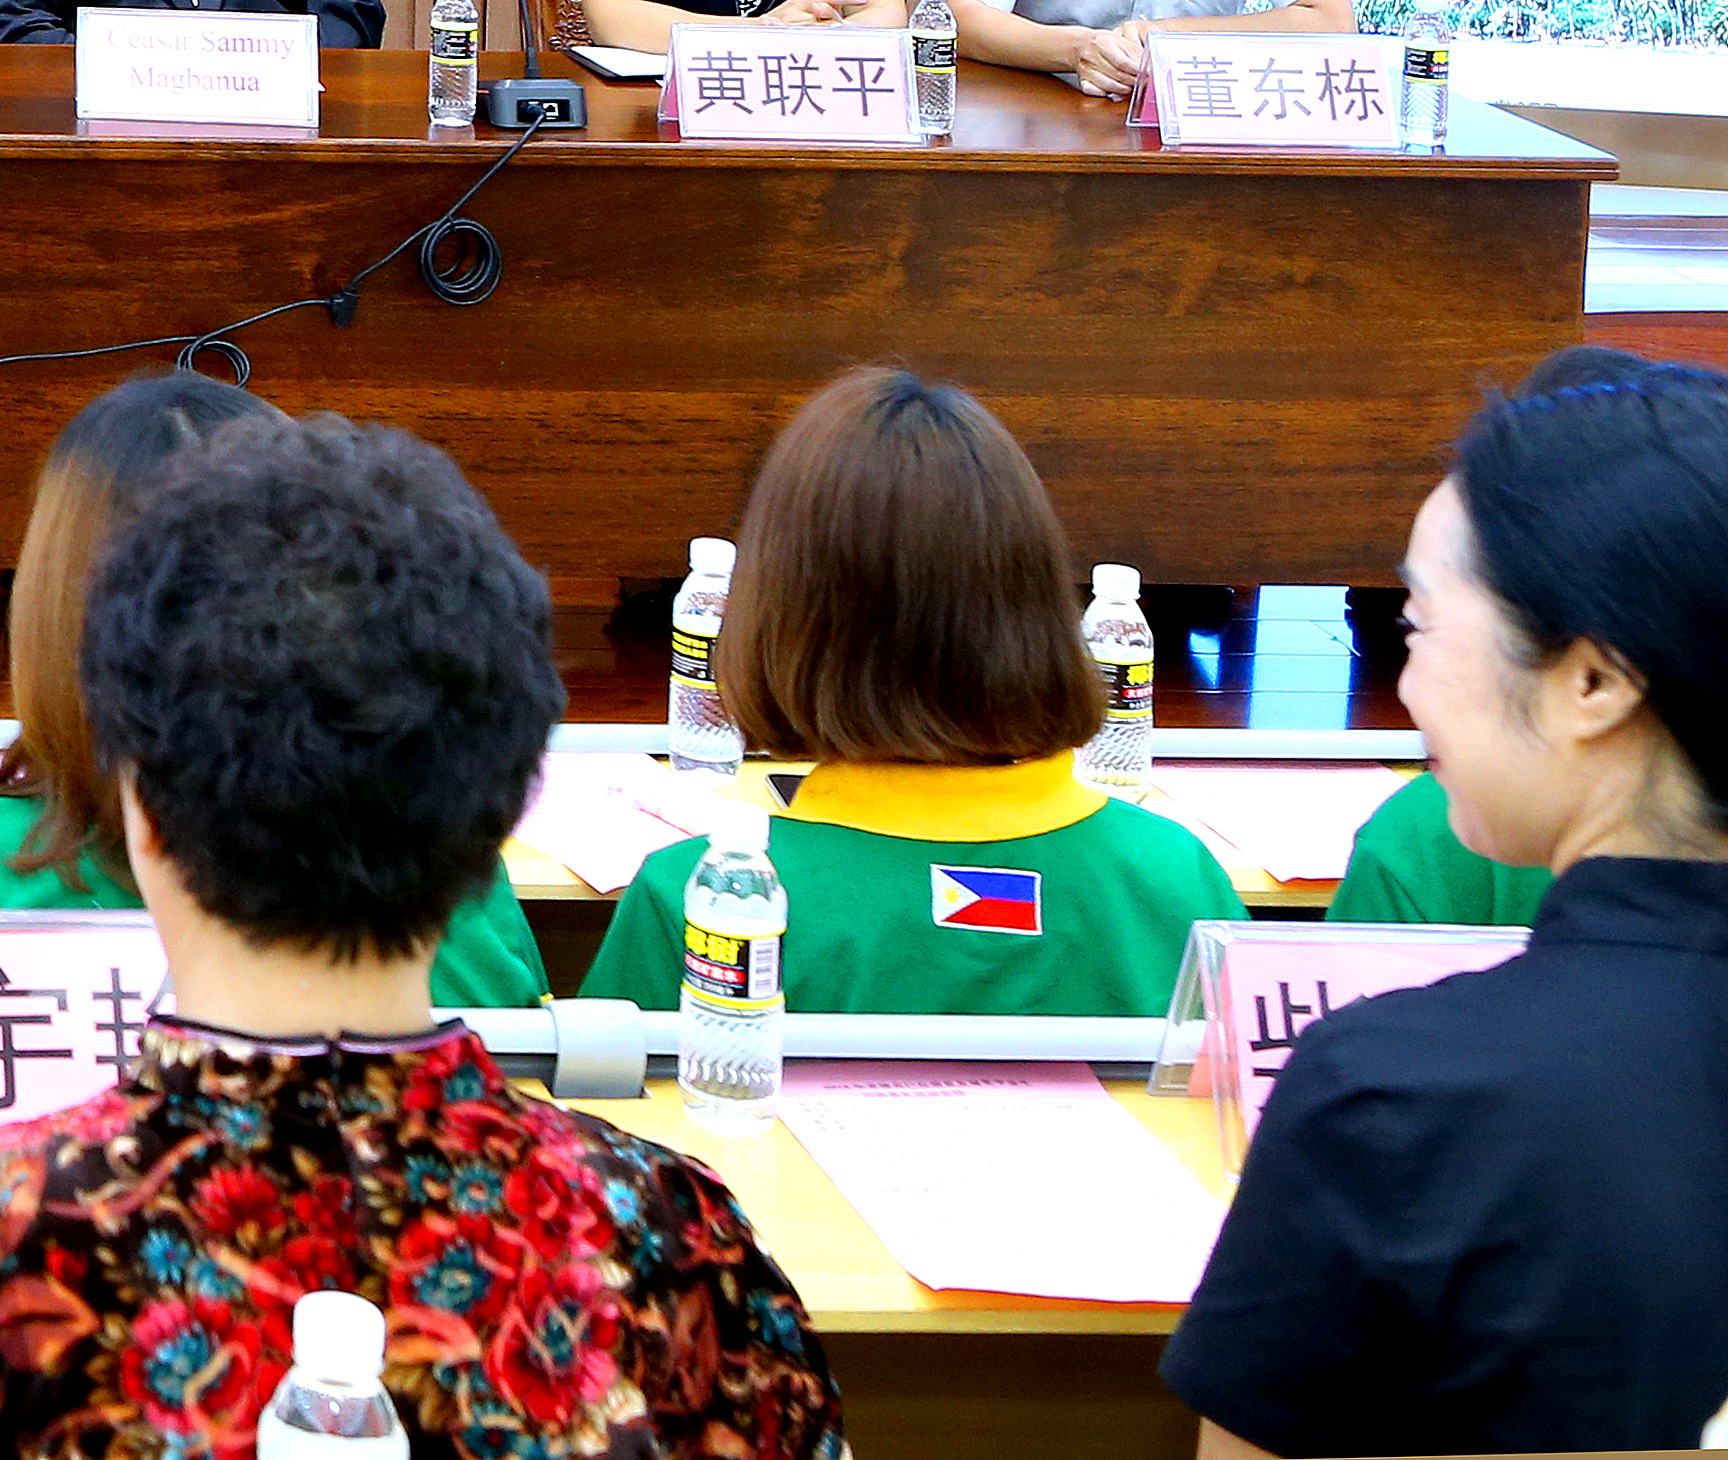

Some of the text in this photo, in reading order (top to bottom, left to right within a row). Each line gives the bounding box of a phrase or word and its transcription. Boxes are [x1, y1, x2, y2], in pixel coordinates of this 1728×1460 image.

[108, 26, 295, 60] Ceasar Sammy
[129, 66, 261, 95] Magbanua
[687, 51, 896, 117] 黄联平
[1176, 56, 1384, 121] 董东栋
